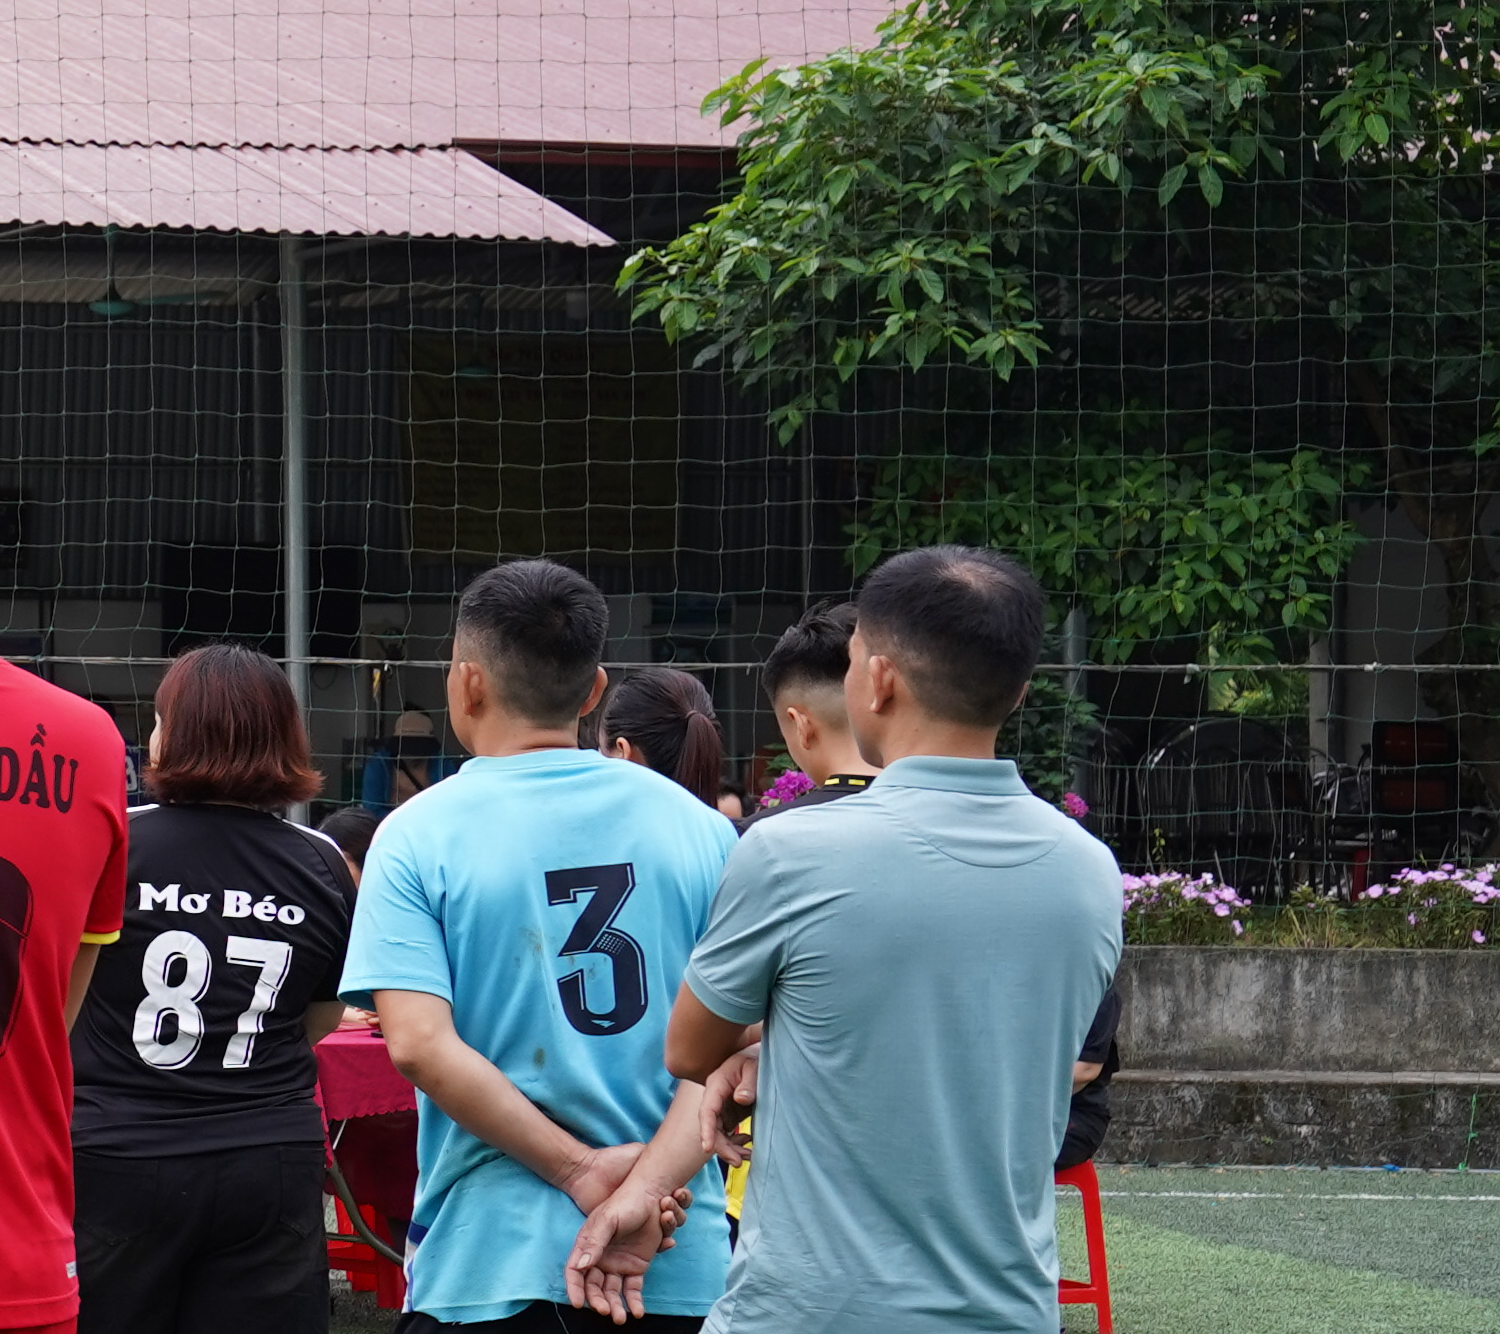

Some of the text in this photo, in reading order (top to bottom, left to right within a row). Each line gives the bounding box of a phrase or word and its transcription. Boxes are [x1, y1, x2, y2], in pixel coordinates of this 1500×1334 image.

[138, 883, 306, 925] Mơ Béo
[544, 863, 649, 1036] 3
[132, 930, 293, 1070] 87
